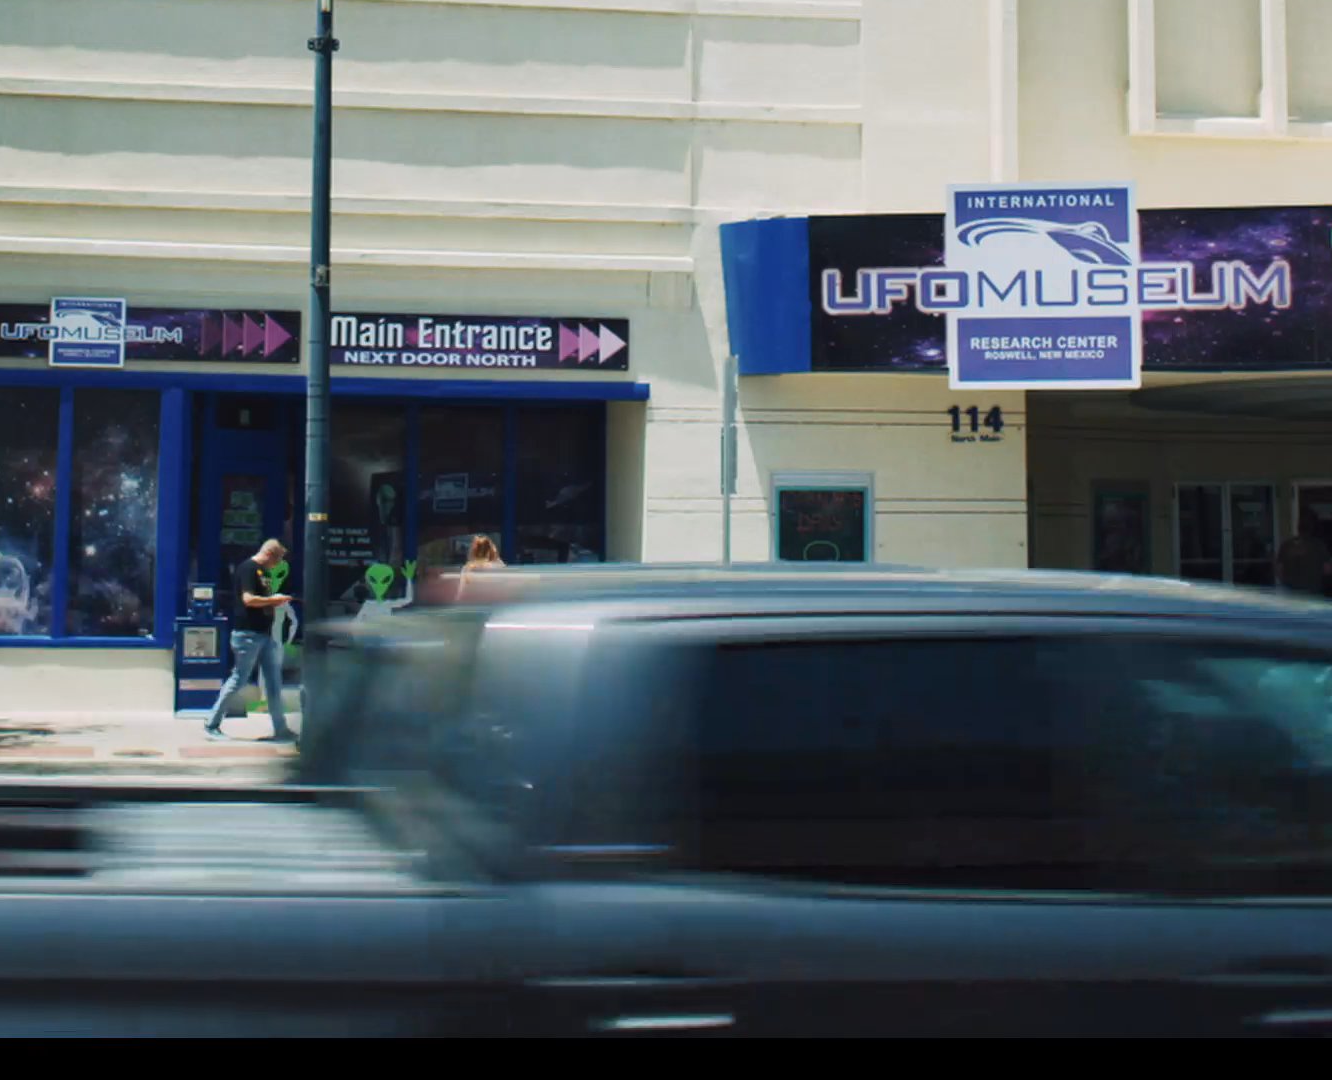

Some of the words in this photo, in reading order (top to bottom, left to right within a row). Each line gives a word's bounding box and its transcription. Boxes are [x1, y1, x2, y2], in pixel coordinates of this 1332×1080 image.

[968, 194, 1115, 209] INTERNATIONAL
[330, 316, 403, 348] Main
[417, 318, 552, 350] Entrance
[970, 336, 1052, 350] RESEARCH
[1057, 335, 1118, 349] CENTER
[344, 351, 398, 364] NEXT
[401, 352, 461, 365] DOOR
[466, 354, 537, 367] NORTH
[947, 404, 1005, 432] 114
